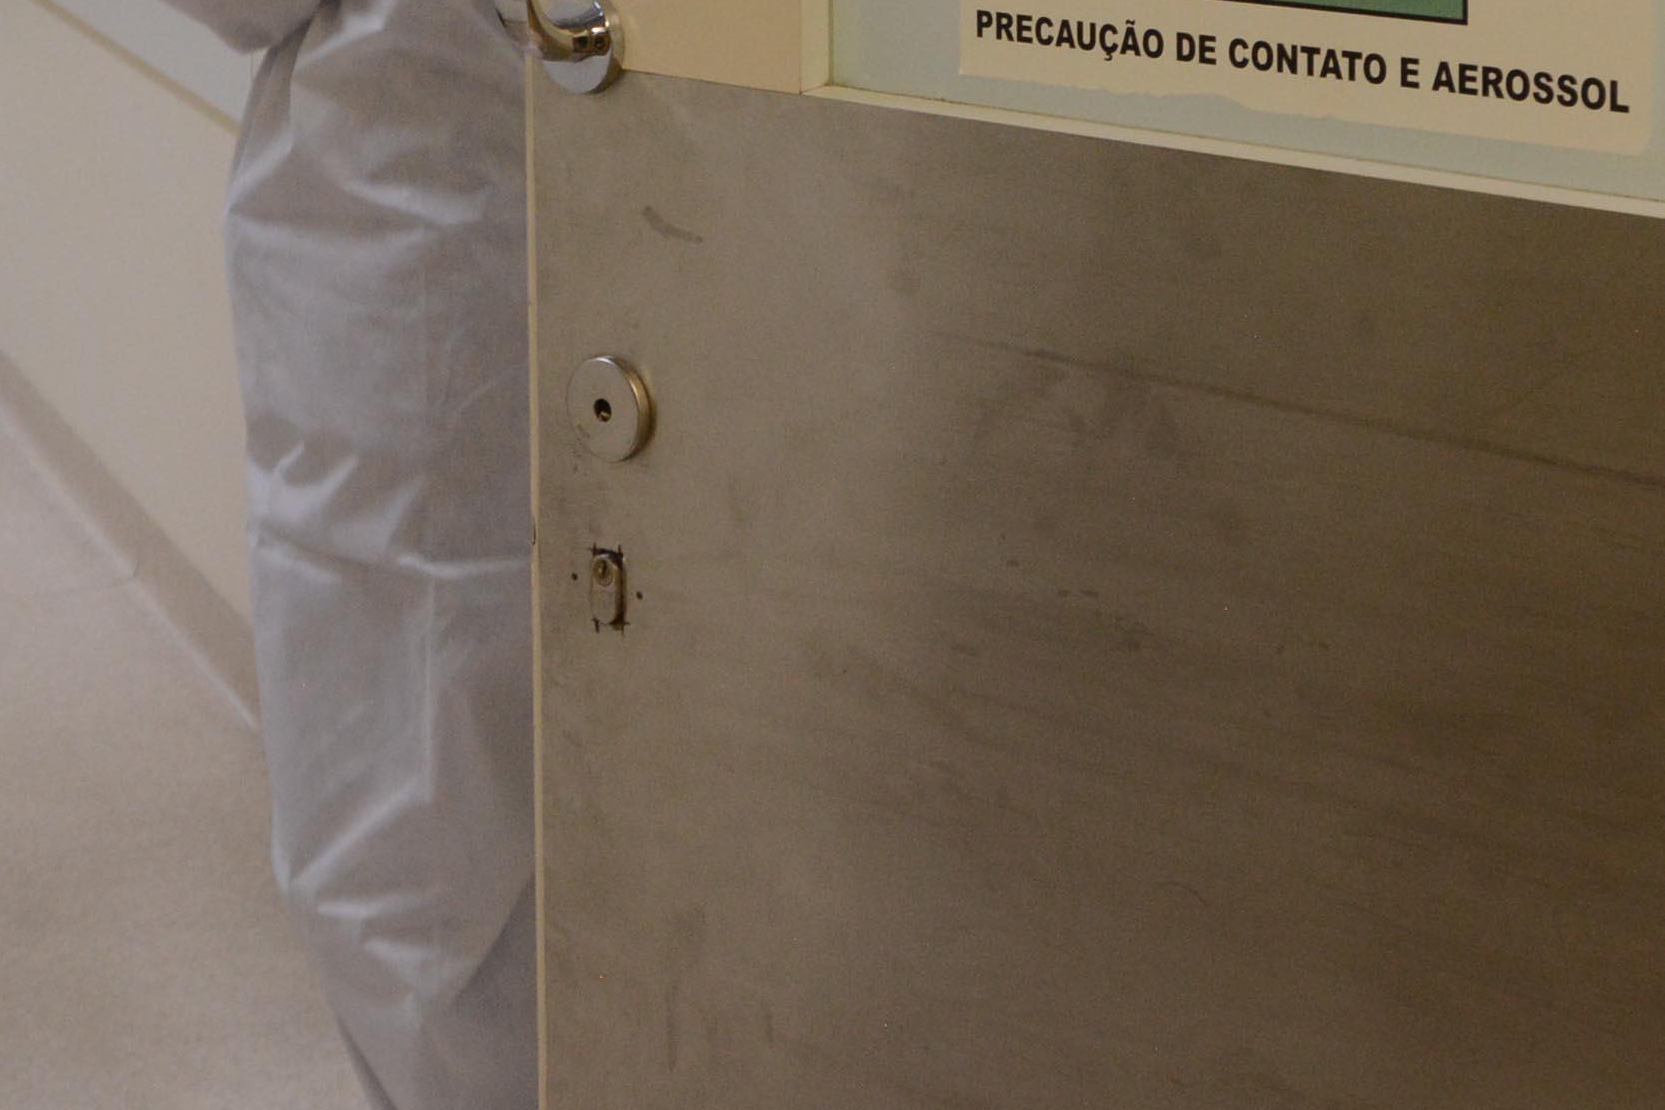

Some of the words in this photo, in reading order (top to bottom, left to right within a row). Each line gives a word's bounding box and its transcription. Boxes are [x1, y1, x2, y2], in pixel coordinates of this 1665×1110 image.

[976, 9, 1164, 62] PRECAUÇÃO
[1176, 31, 1217, 66] DE
[1228, 38, 1387, 85] CONTATO
[1400, 56, 1420, 89] E
[1431, 61, 1630, 114] AEROSSOL
